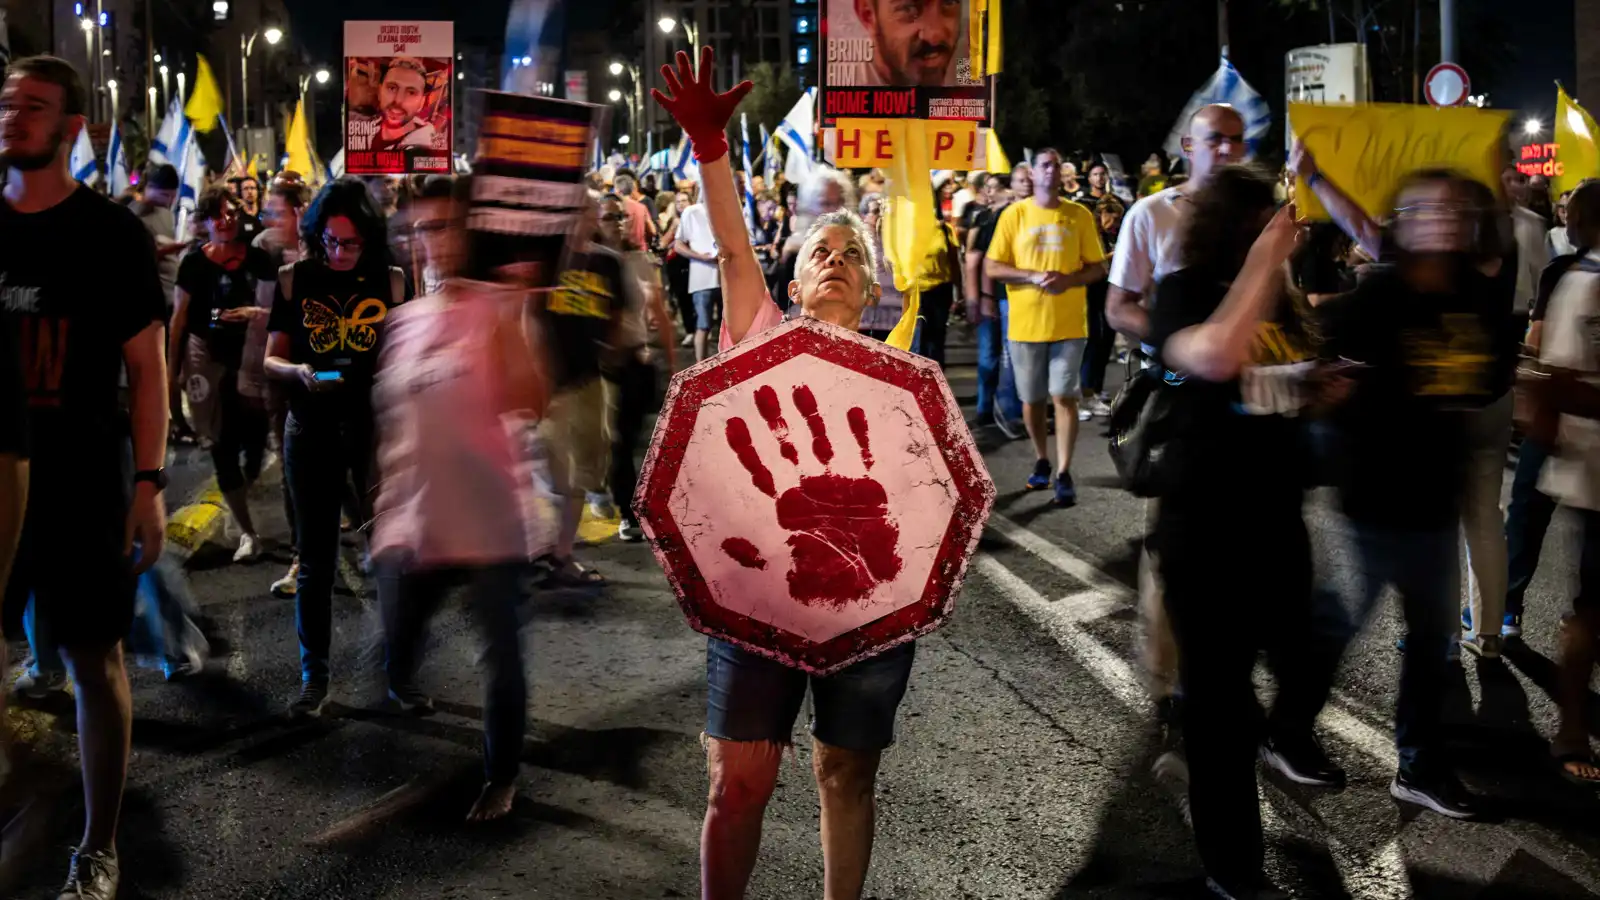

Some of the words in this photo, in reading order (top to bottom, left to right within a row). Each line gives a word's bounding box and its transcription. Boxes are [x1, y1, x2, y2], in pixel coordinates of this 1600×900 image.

[827, 38, 874, 62] BRING
[827, 63, 857, 86] HIM
[826, 91, 870, 115] HOME
[873, 88, 917, 115] NOW!
[929, 106, 960, 117] FAMILIES
[961, 107, 985, 117] FORUM
[348, 121, 376, 135] BRING
[348, 136, 366, 150] HIM
[836, 128, 975, 162] HEP!
